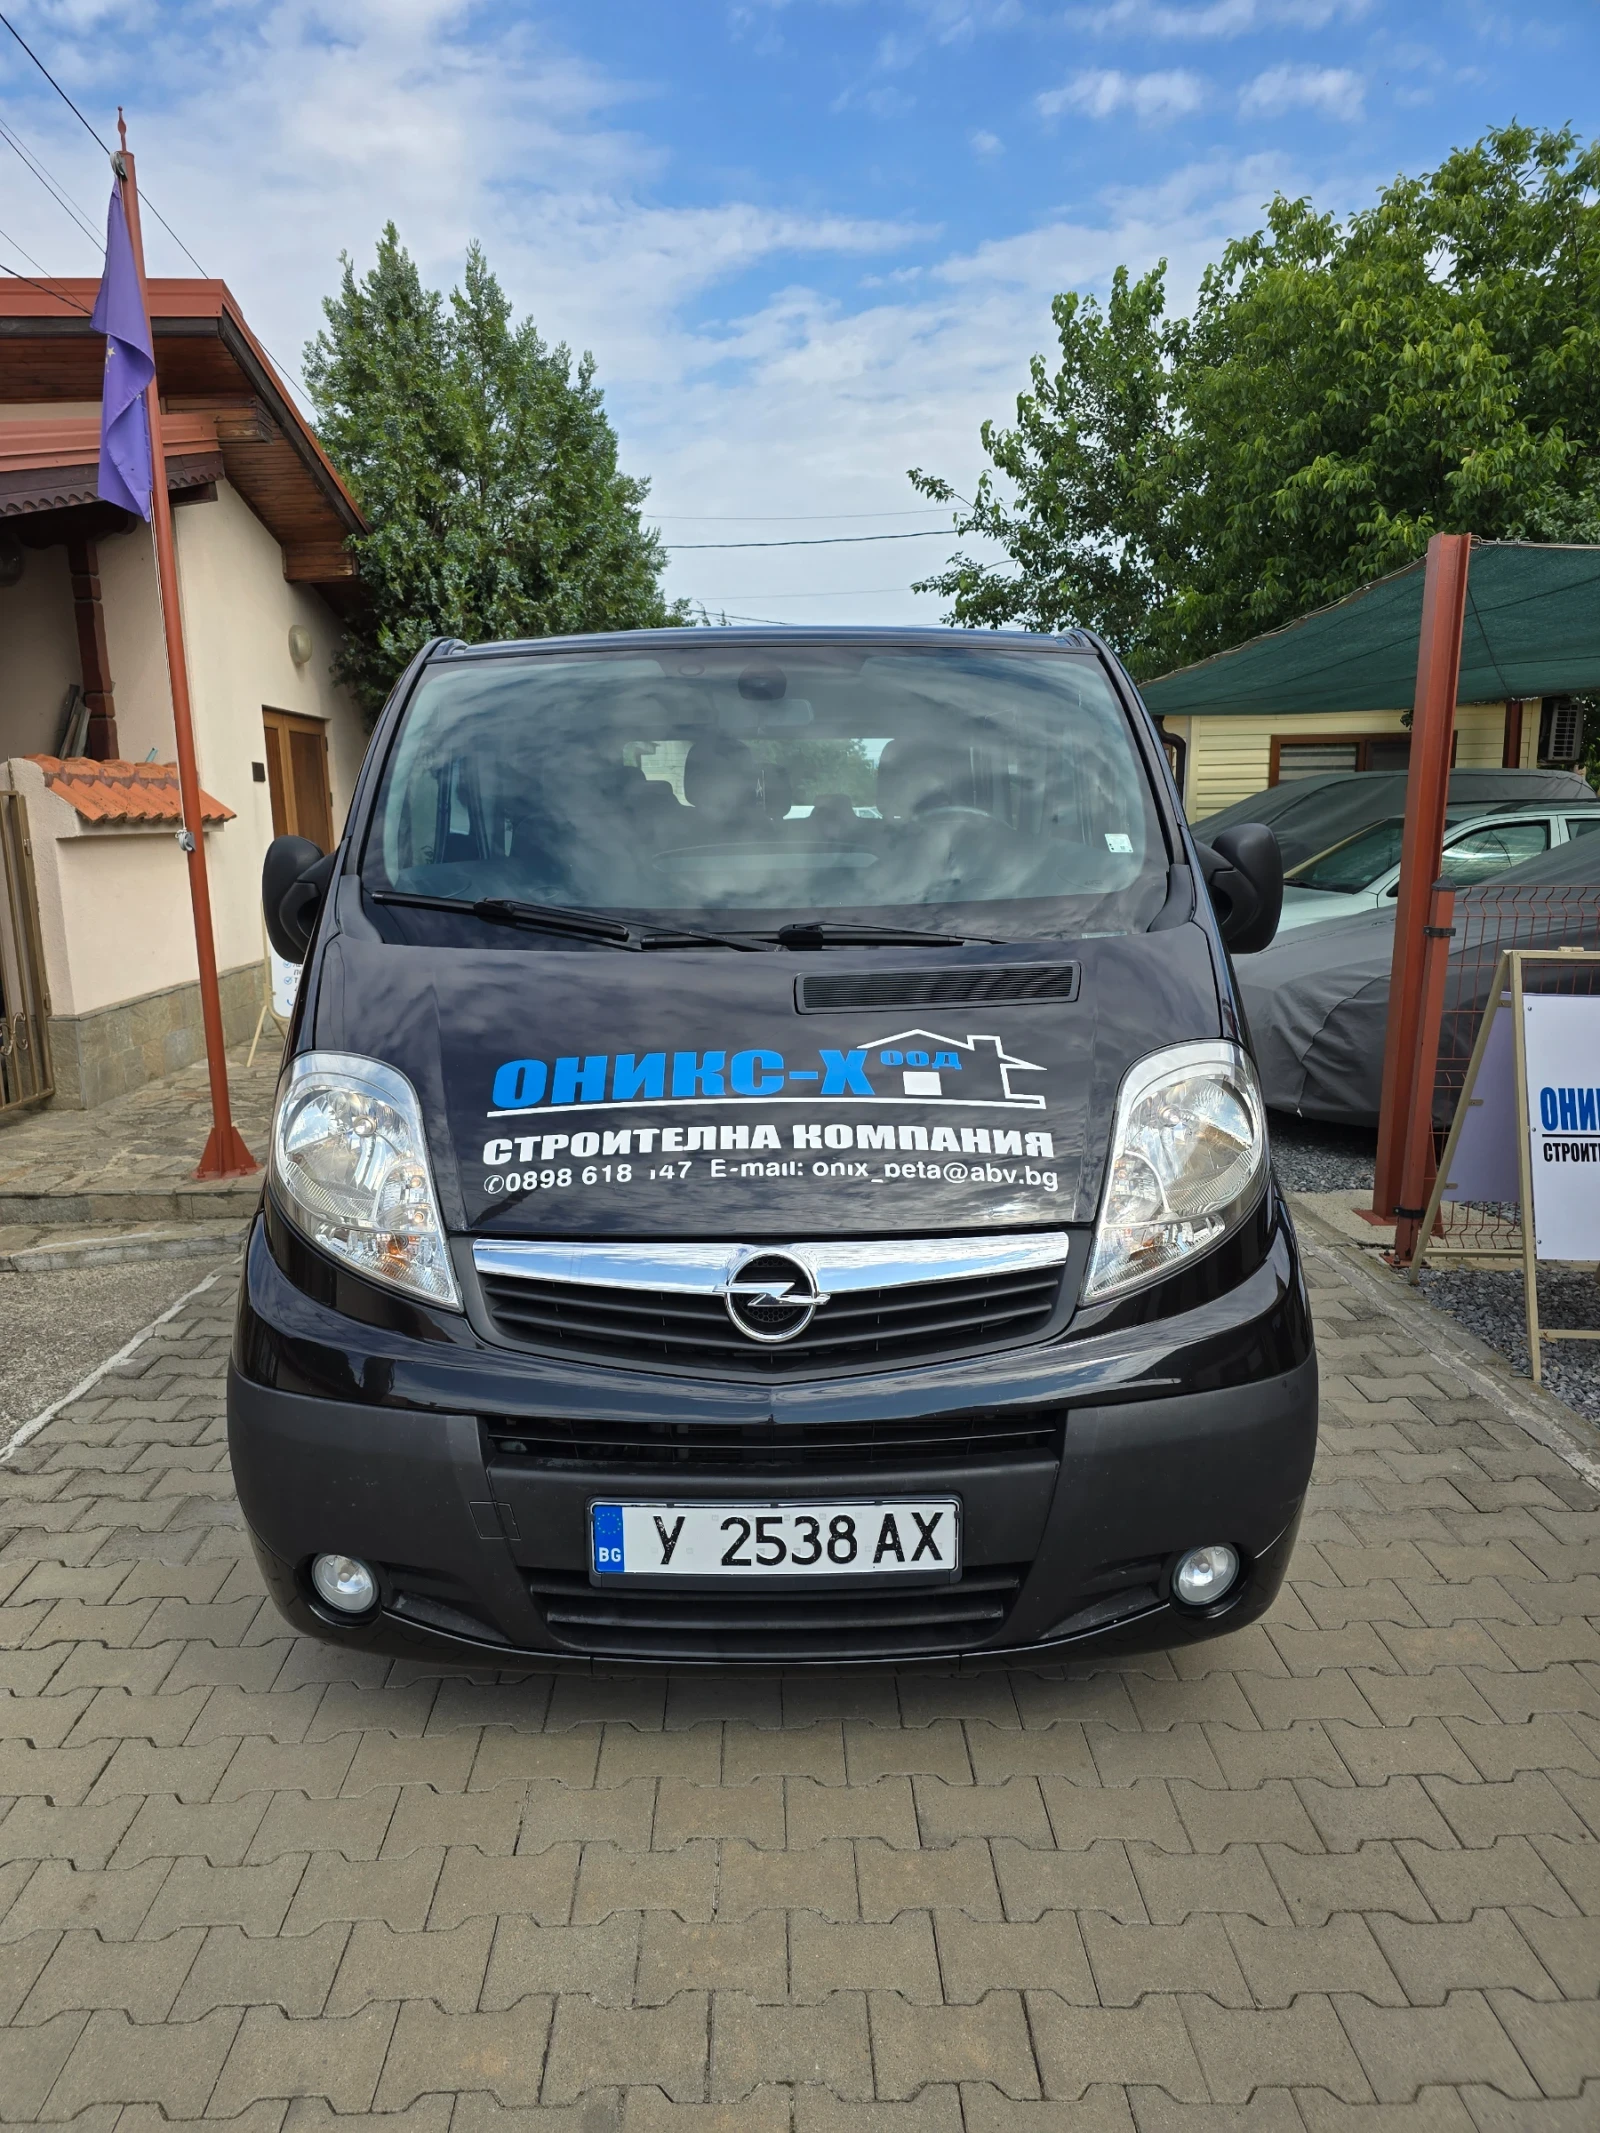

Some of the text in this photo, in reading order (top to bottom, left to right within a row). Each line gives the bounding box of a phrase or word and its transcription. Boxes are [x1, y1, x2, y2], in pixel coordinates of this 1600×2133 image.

[482, 1123, 1054, 1166] СТРОИТЕЛНА КОМПАНИЯ
[581, 1163, 632, 1185] 618
[711, 1158, 803, 1178] E-mail:
[812, 1161, 1059, 1192] onix_peta@abv.bg
[599, 1547, 622, 1563] BG
[720, 1514, 858, 1566] 2538
